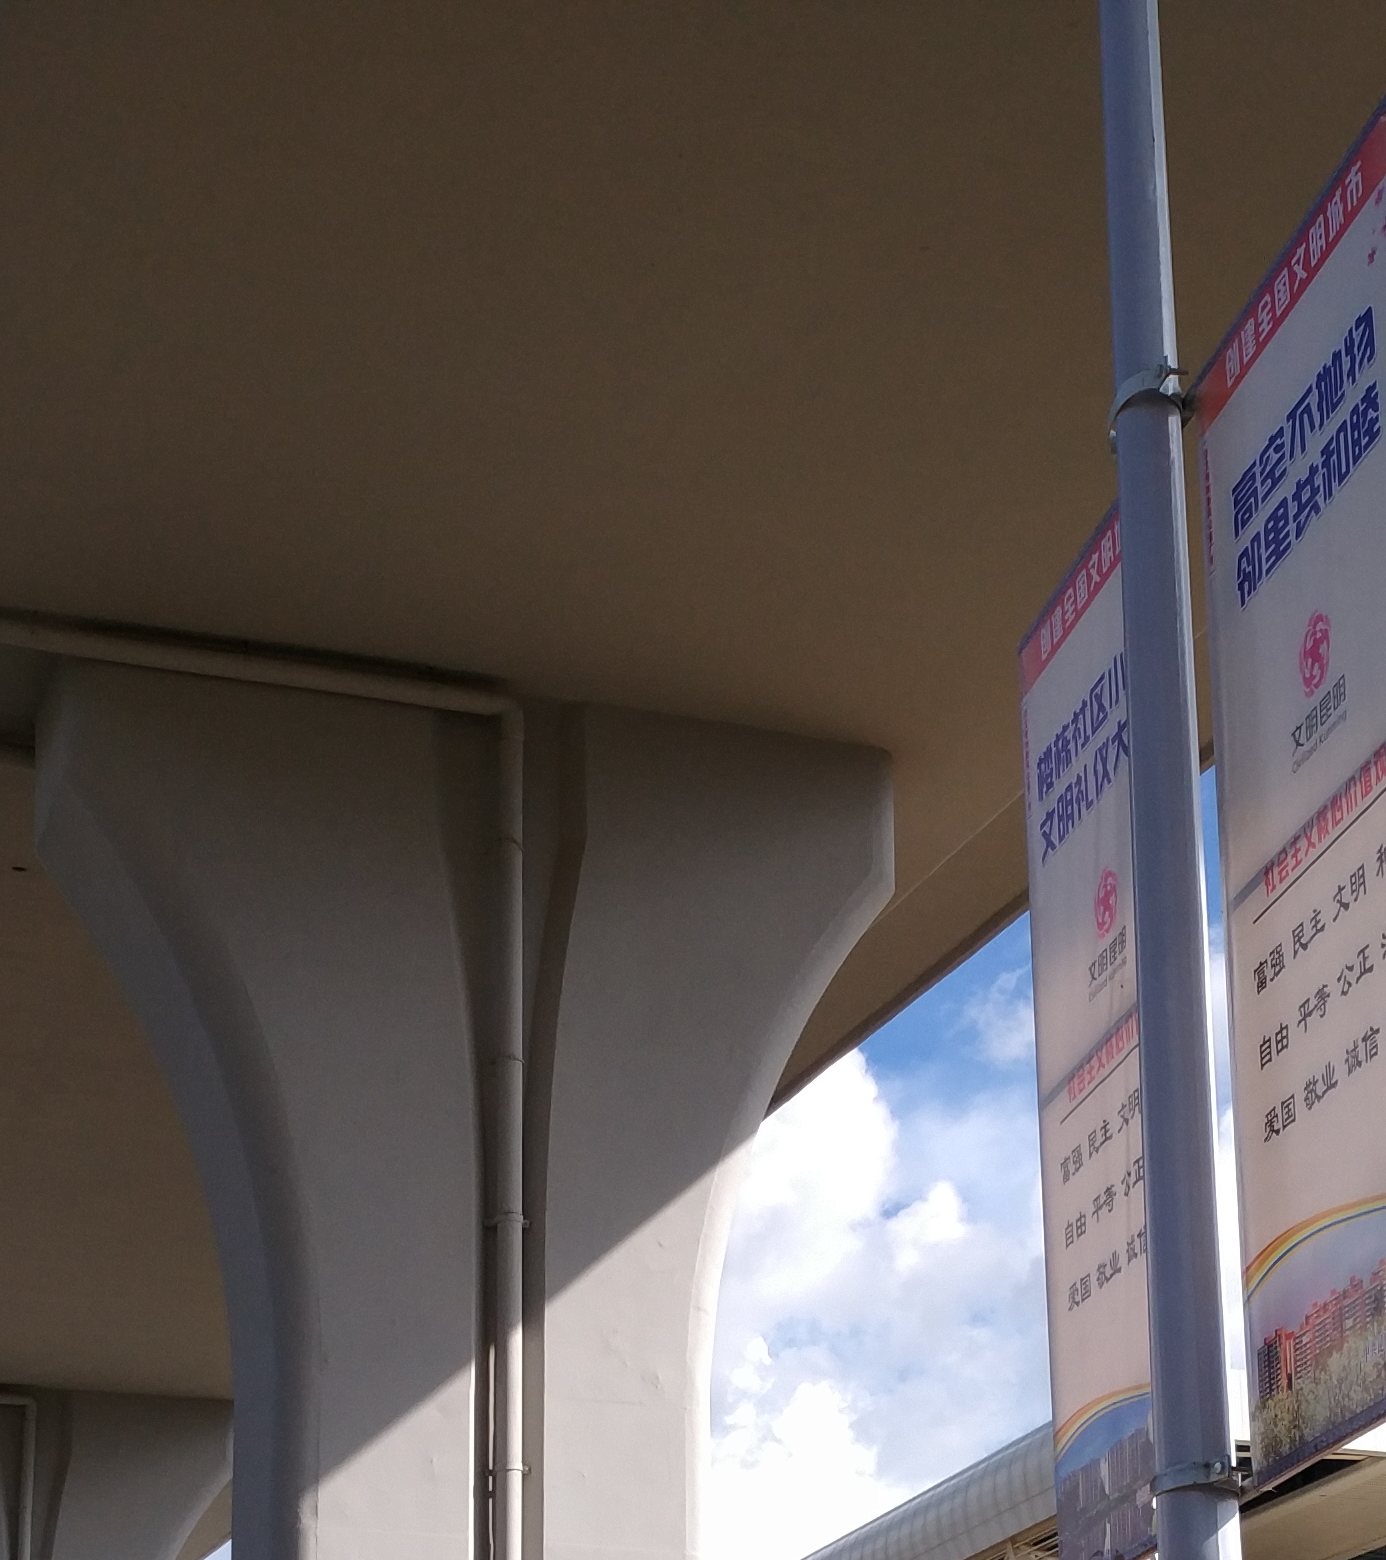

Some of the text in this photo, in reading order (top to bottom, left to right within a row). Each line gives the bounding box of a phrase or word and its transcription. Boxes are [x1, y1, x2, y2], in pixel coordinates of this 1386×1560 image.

[1225, 160, 1362, 388] 创建全国文明城市
[1232, 306, 1377, 542] 高空不抛物
[1237, 380, 1382, 611] 邻里共和睦
[1291, 674, 1346, 757] 文明昆明
[1040, 718, 1130, 867] 文明礼仪大
[1088, 925, 1127, 988] 文明昆明
[1253, 942, 1286, 995] 富强
[1292, 909, 1326, 960] 民主
[1333, 863, 1367, 923] 文明
[1067, 1012, 1139, 1103] 社会主义核心价
[1259, 1023, 1289, 1071] 自由
[1297, 984, 1331, 1033] 平等
[1337, 944, 1374, 997] 公正
[1060, 1088, 1141, 1185] 富强 民主 文明
[1264, 1093, 1296, 1143] 爱国
[1304, 1061, 1338, 1111] 敬业
[1345, 1026, 1380, 1077] 诚信
[1065, 1156, 1144, 1250] 自由 平等 公正
[1068, 1272, 1092, 1311] 爱国
[1096, 1250, 1122, 1290] 敬业
